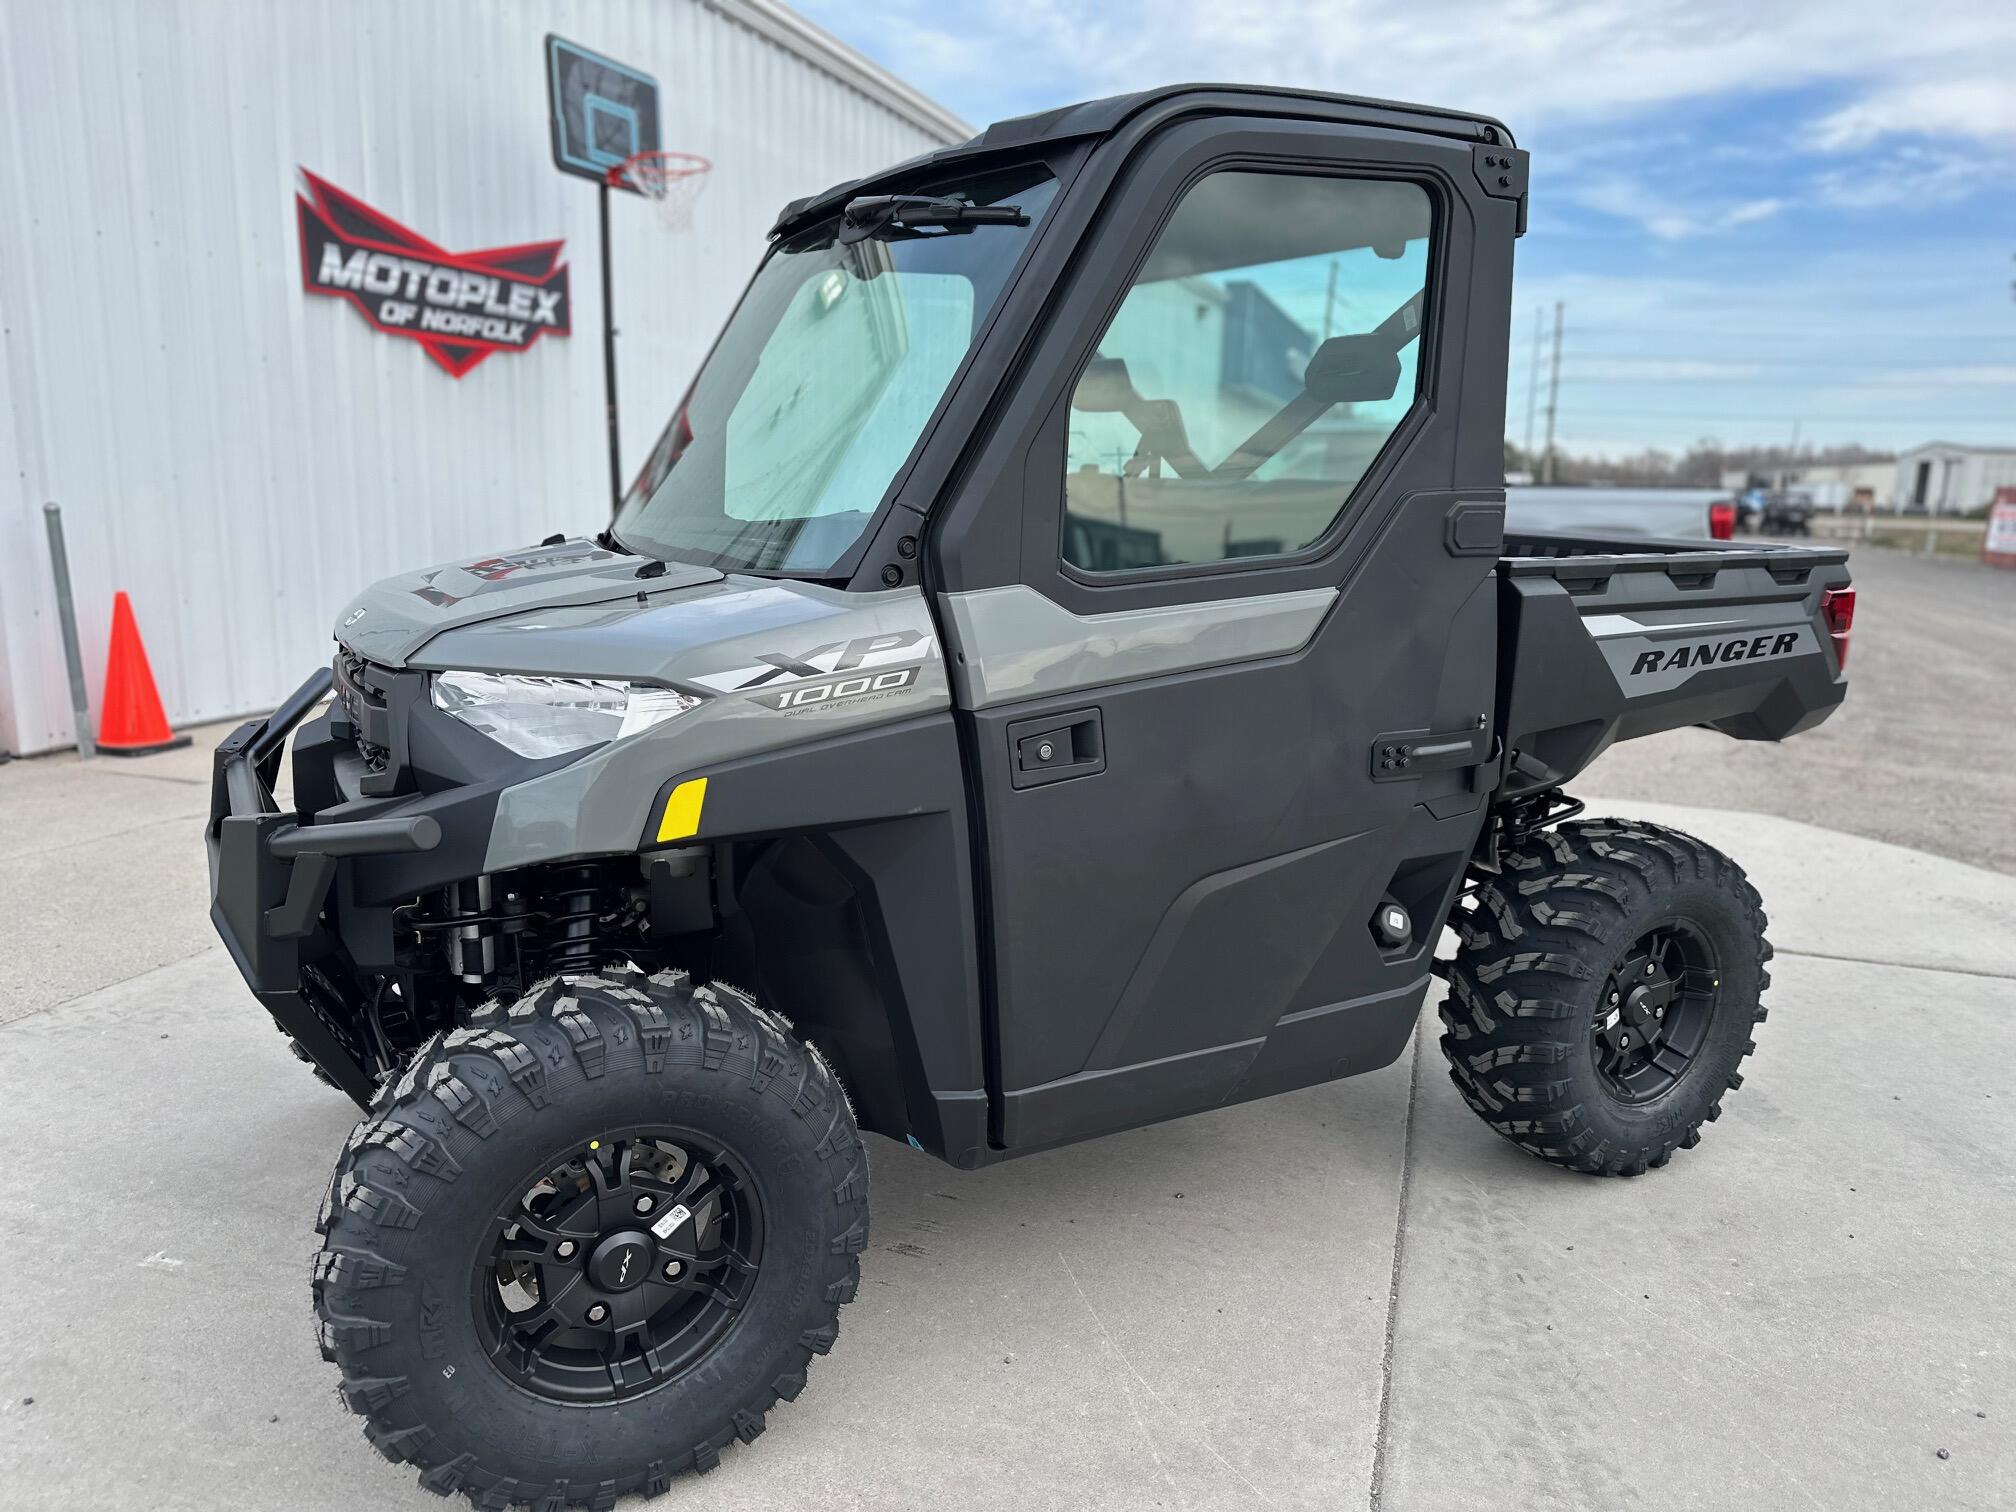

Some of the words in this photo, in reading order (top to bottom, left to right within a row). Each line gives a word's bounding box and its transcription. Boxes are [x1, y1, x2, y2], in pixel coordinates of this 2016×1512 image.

[318, 242, 562, 325] MOTOPLEX
[379, 300, 418, 326] OF
[421, 305, 528, 345] NORFOLK
[732, 629, 925, 690] XP
[1629, 632, 1799, 676] RANGER
[777, 670, 910, 709] 1000
[783, 706, 816, 718] DUAL
[820, 693, 883, 711] OVERHEAD
[885, 688, 912, 699] CAM
